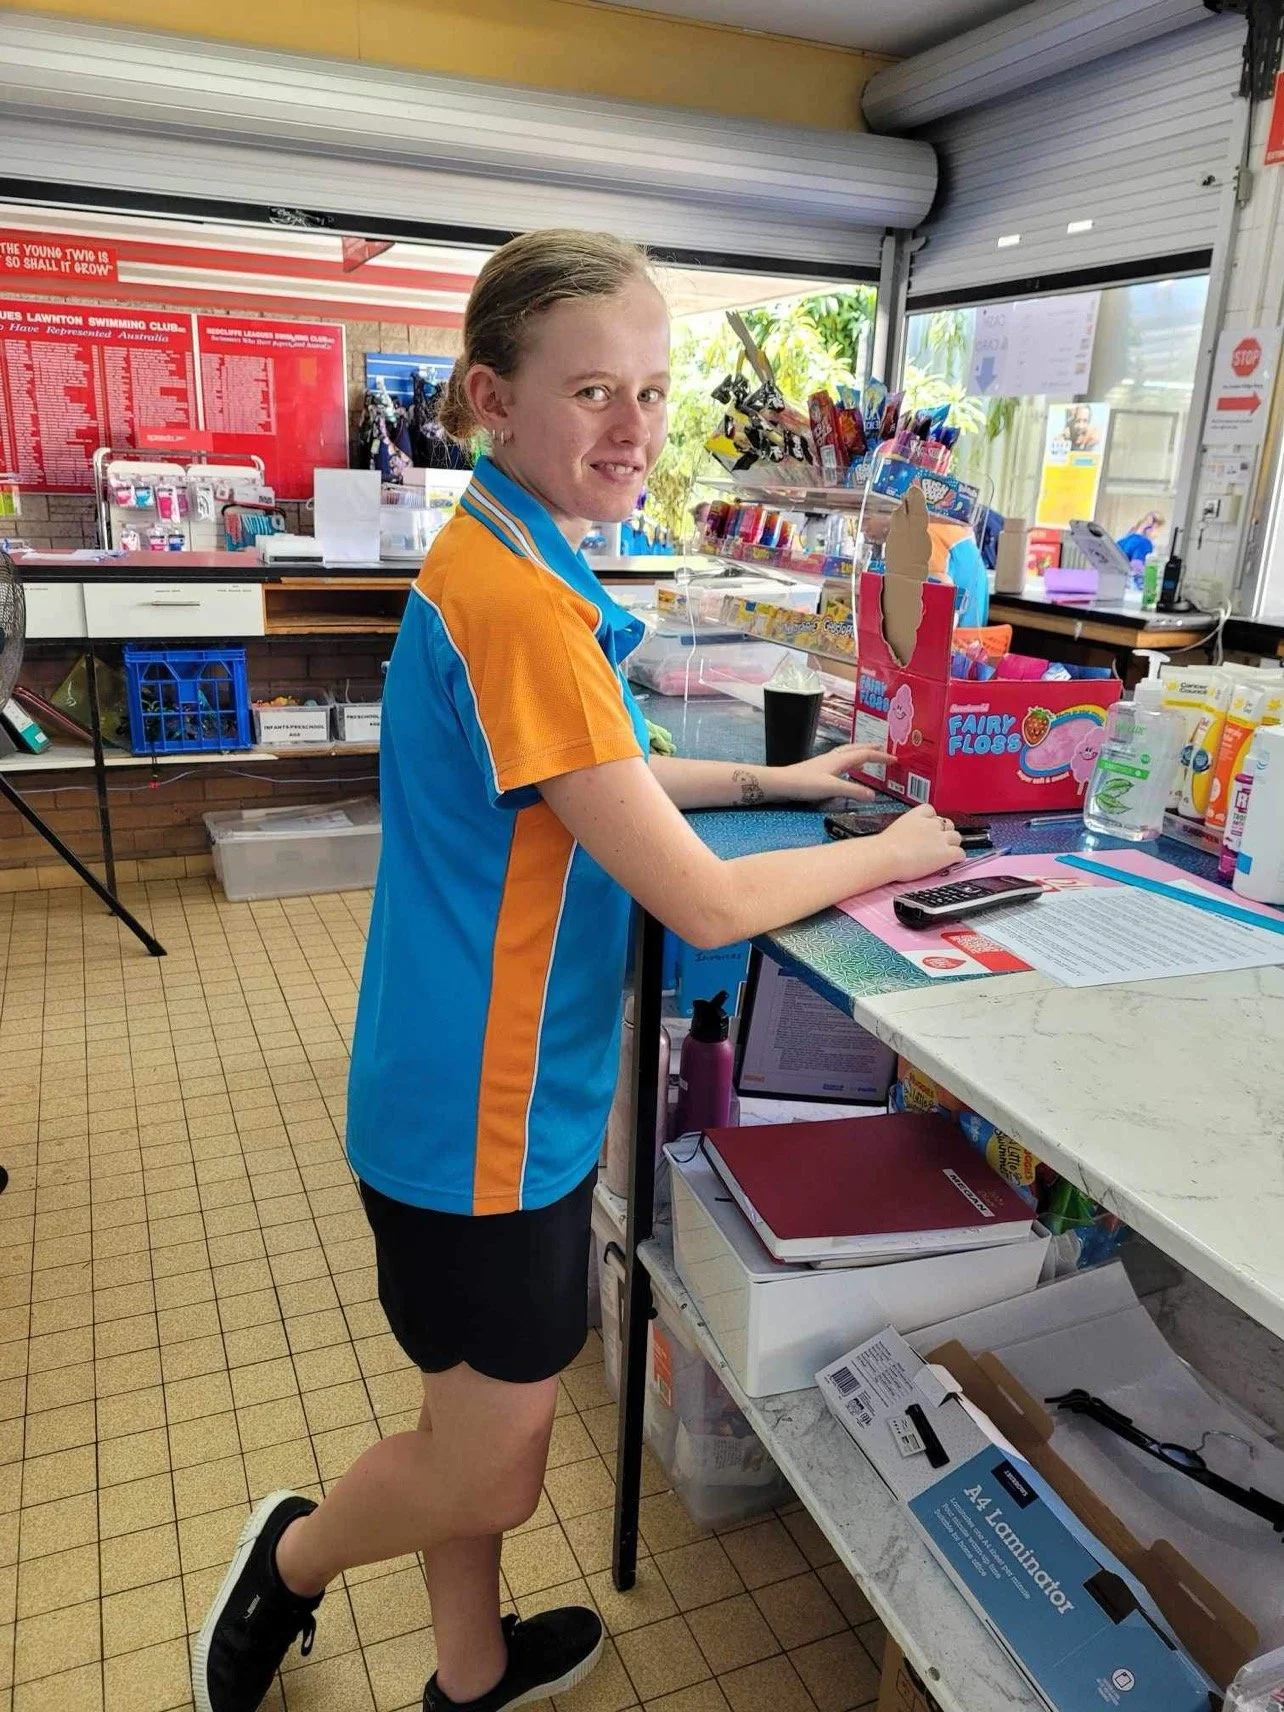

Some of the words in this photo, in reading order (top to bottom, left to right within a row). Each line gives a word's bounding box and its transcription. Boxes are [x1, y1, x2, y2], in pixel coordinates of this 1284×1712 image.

[23, 244, 62, 259] YOUNG
[65, 249, 95, 262] TWIG
[98, 251, 109, 263] IS
[5, 256, 20, 268] SO
[23, 257, 59, 271] SHALL
[60, 261, 71, 273] IT
[27, 313, 83, 325] LAWNTON
[88, 317, 147, 330] SWIMMING
[10, 323, 40, 333] Have
[47, 326, 112, 338] Represented
[118, 331, 169, 342] Australia
[1233, 349, 1261, 366] STOP
[1179, 689, 1208, 698] Council
[1180, 682, 1209, 690] Cancer
[949, 714, 1017, 736] FAIRY
[948, 733, 1022, 757] FLOSS
[949, 1173, 987, 1211] MEGAN
[964, 1485, 992, 1512] A4
[985, 1509, 1074, 1614] Laminator
